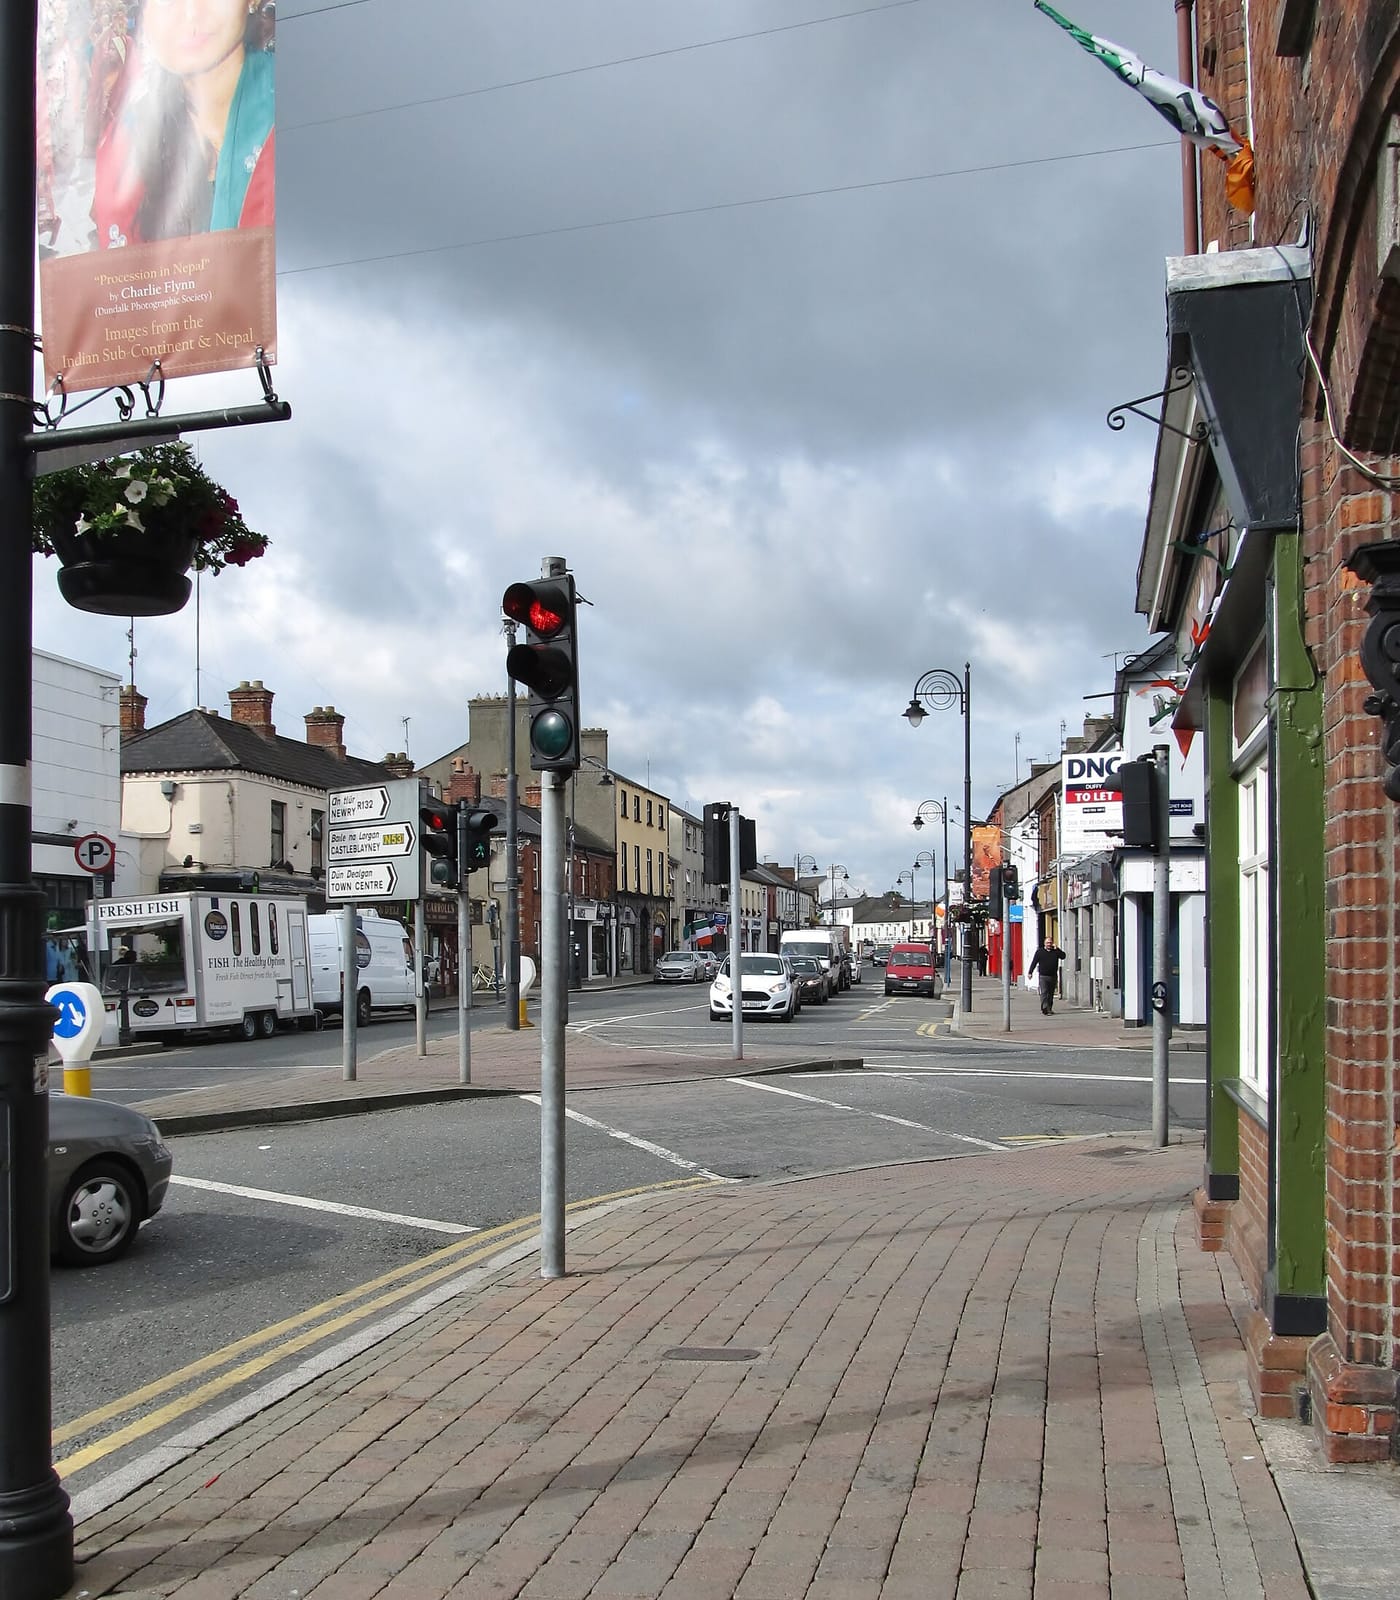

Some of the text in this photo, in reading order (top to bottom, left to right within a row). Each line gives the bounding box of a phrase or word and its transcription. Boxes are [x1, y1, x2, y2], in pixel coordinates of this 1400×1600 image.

[160, 267, 170, 278] in
[109, 280, 195, 302] by Charlie Flynn
[94, 290, 213, 318] (Dundalk Photographic Society)
[105, 315, 204, 343] Images from the
[62, 327, 254, 369] Indian Sub-Continent & Nepal
[1075, 791, 1114, 802] TO LET
[357, 800, 374, 810] R132
[331, 808, 356, 818] NEWRY
[331, 833, 346, 843] Baile
[359, 831, 380, 842] Lorgan
[383, 834, 403, 845] N53
[88, 841, 104, 865] P
[331, 842, 380, 855] CASTLEBLAYNEY
[331, 869, 373, 879] Dún Dealgan
[331, 880, 383, 892] TOWN CENTRE
[100, 900, 179, 918] FRESH FISH
[208, 955, 285, 969] FISH The Healthy Option
